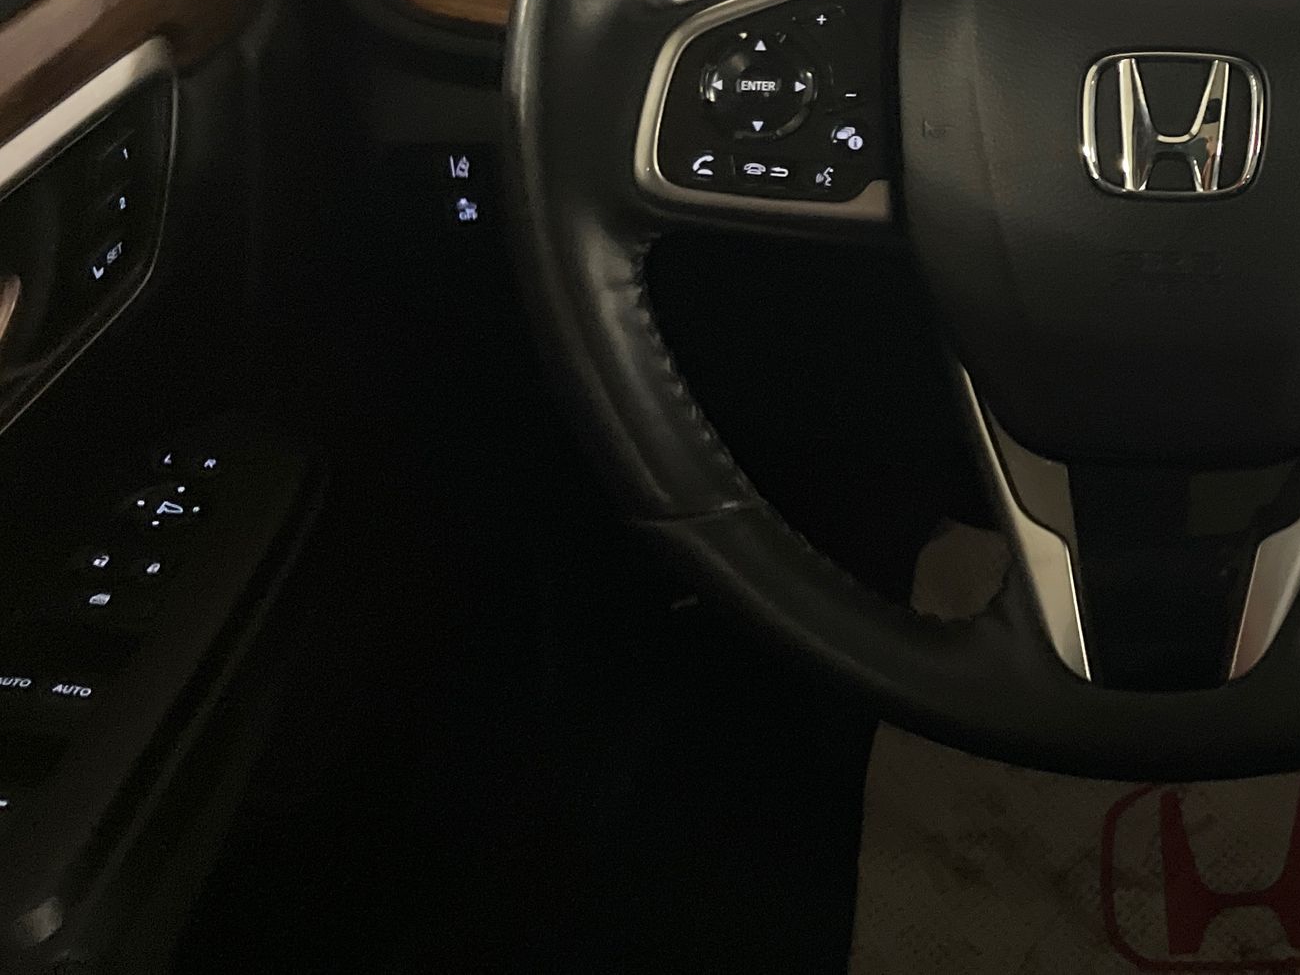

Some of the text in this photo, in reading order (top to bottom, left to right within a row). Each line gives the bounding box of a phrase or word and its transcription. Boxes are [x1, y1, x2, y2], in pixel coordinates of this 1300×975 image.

[740, 80, 776, 91] ENTER
[119, 196, 127, 210] 2
[106, 241, 123, 265] SET
[0, 677, 32, 687] UTO
[52, 684, 92, 698] AUTO
